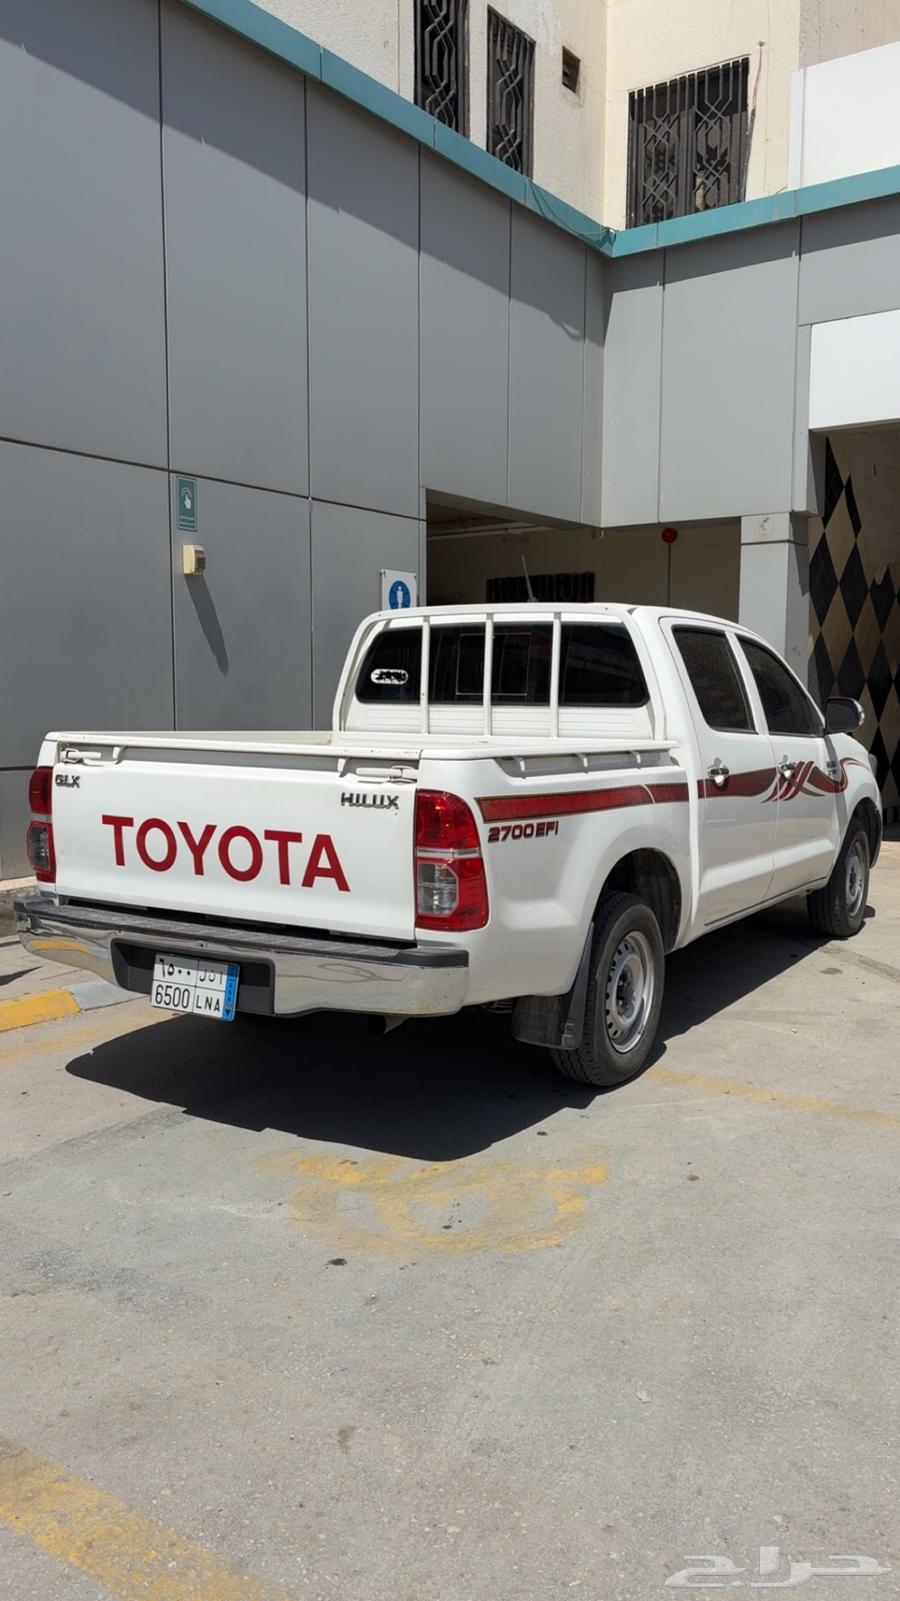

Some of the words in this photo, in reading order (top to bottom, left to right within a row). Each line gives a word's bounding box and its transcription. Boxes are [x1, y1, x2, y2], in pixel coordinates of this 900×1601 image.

[55, 774, 80, 788] GLX
[341, 792, 399, 809] HILUX
[102, 814, 351, 893] TOYOTA
[155, 984, 190, 1009] 6500
[195, 994, 221, 1012] LNA
